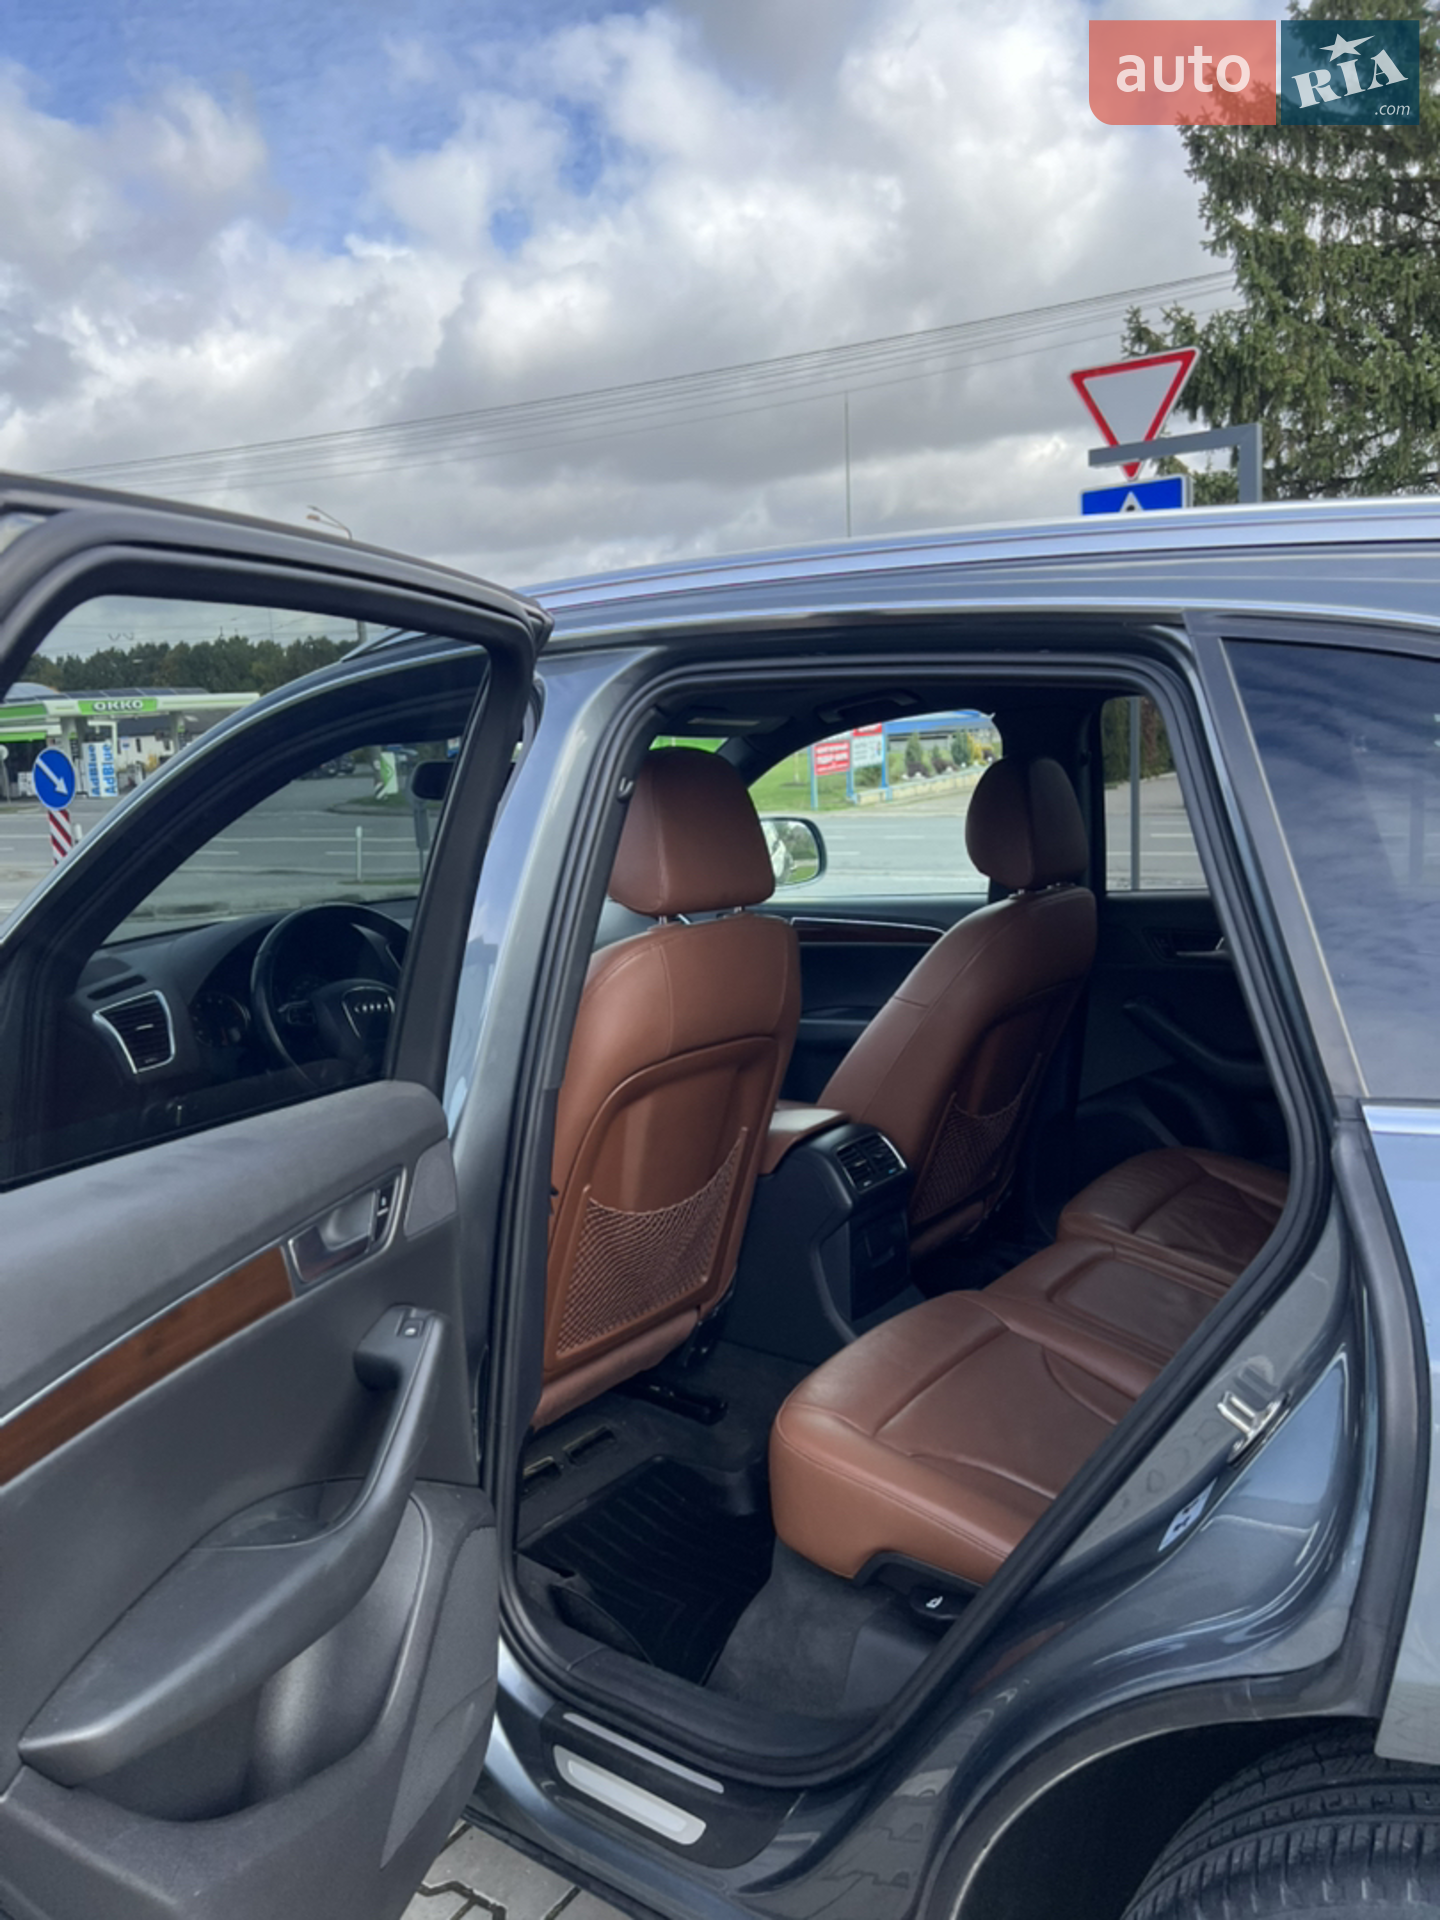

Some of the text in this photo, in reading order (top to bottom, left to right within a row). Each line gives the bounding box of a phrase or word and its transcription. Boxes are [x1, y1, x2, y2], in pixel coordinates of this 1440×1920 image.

[93, 700, 142, 711] OKKO
[88, 744, 100, 795] AdBlue
[102, 744, 116, 794] AdBlue
